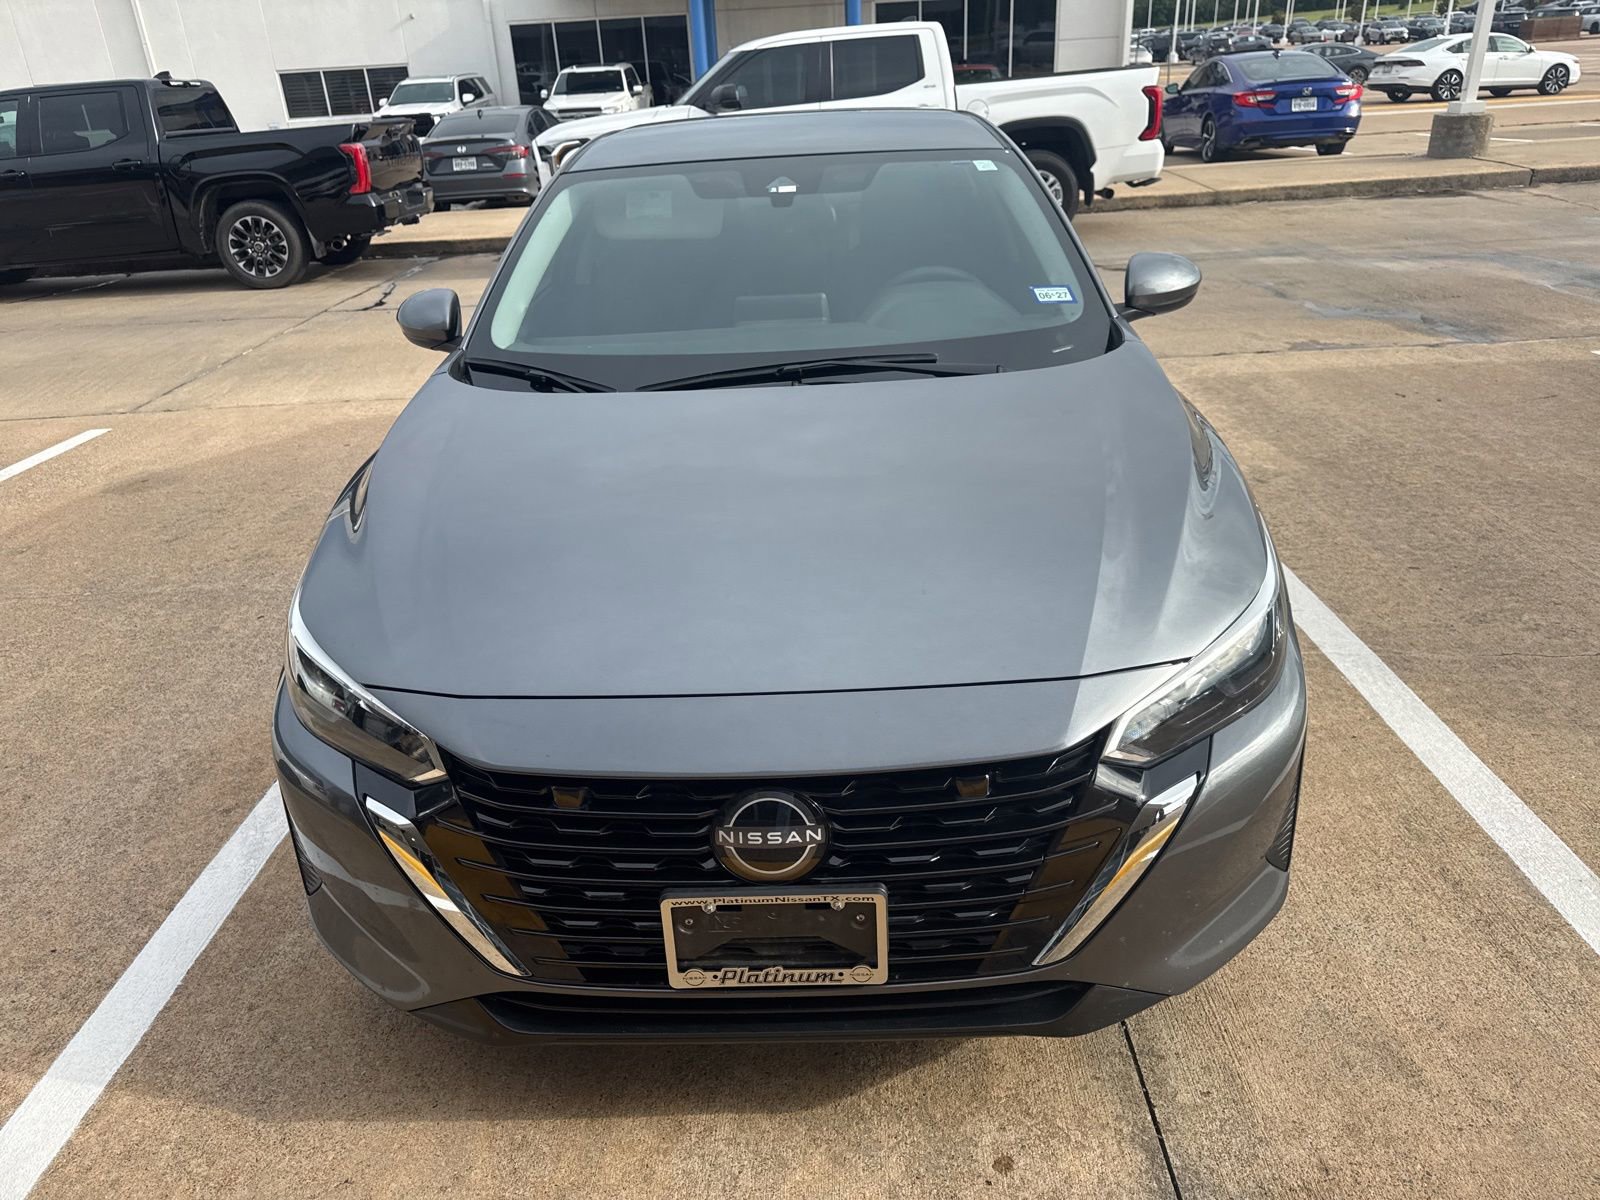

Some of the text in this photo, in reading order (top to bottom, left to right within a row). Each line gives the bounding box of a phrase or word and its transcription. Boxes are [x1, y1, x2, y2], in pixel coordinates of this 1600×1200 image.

[718, 827, 823, 845] NISSAN
[671, 895, 875, 906] www.PlatinumNissanTX.com
[719, 968, 844, 985] Platinum
